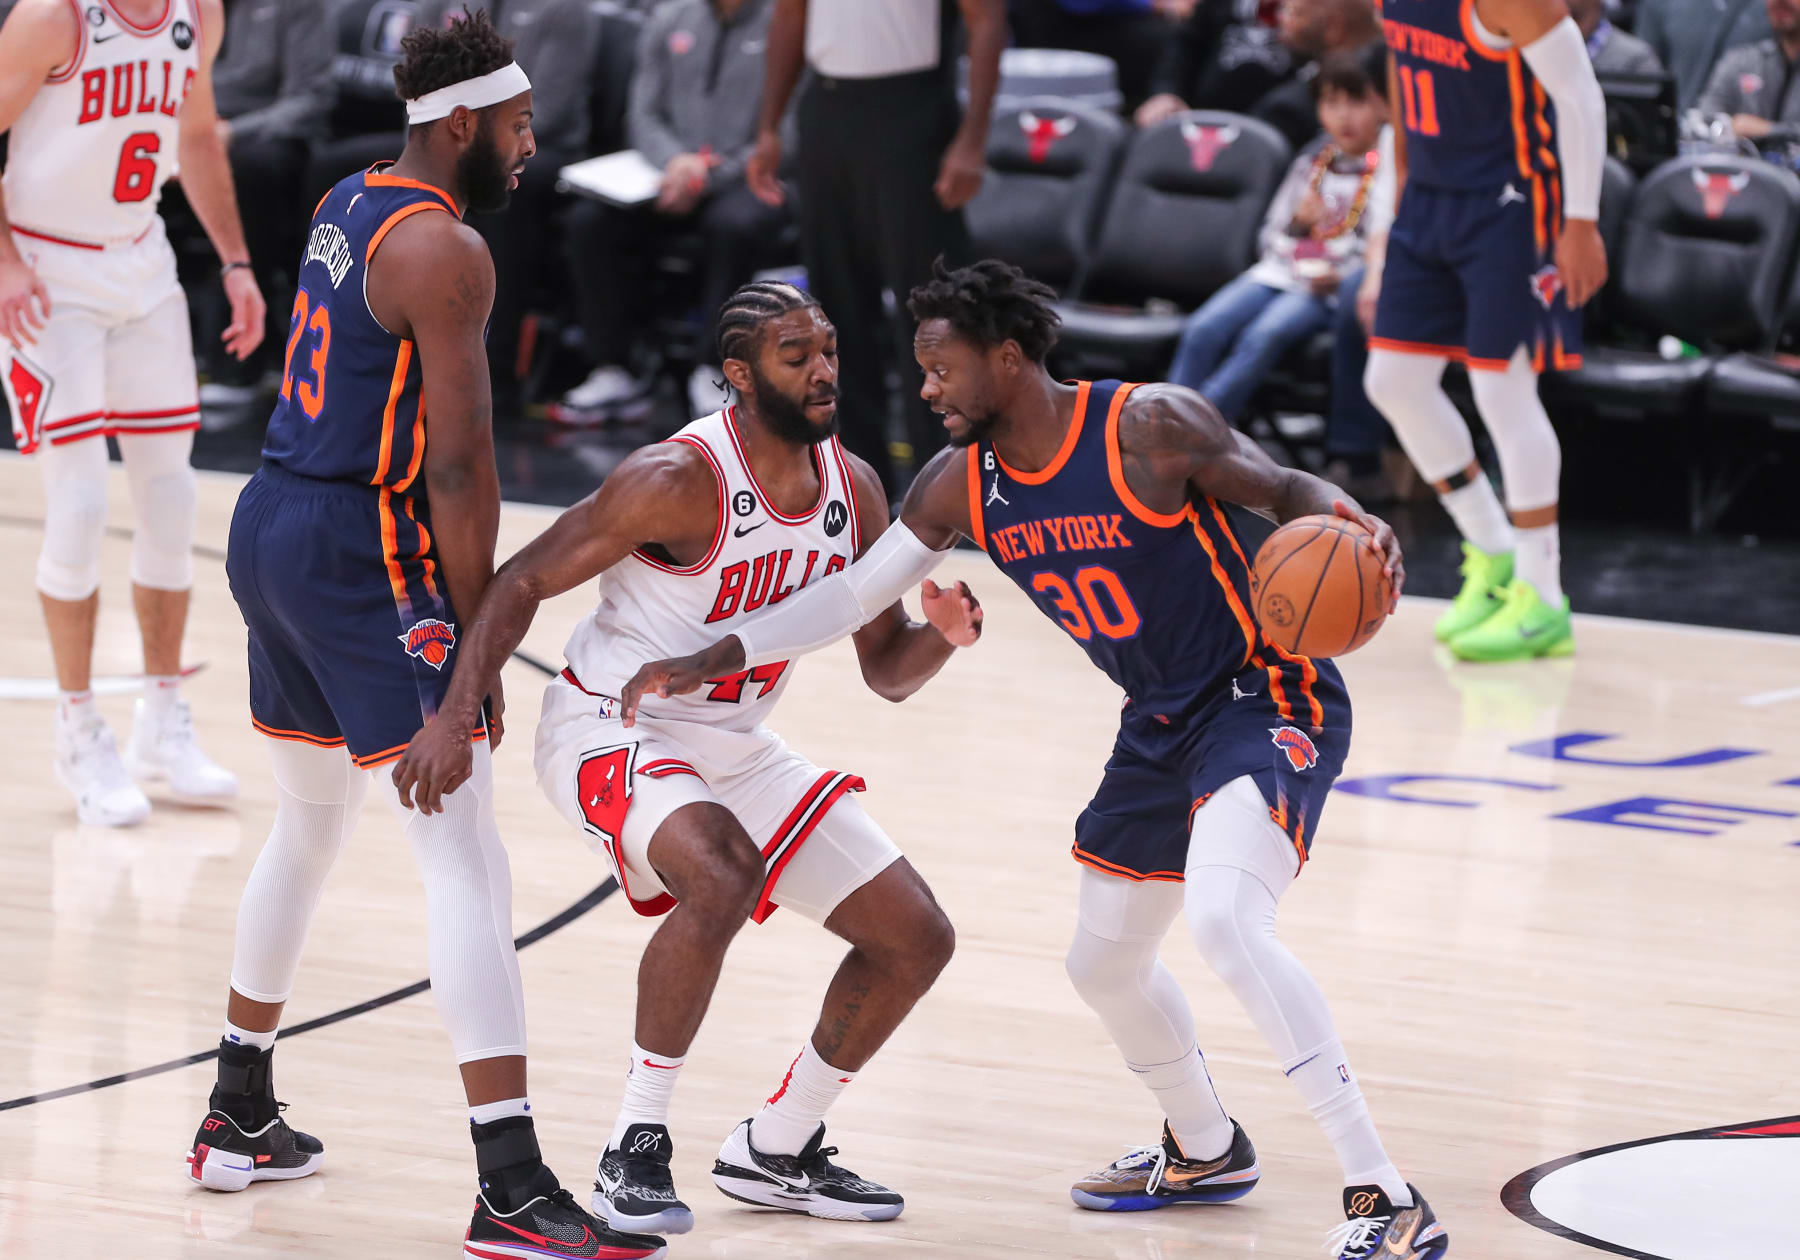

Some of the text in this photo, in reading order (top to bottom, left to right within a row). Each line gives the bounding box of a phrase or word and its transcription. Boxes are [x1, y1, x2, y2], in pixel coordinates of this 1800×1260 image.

[1399, 64, 1440, 136] 11
[113, 132, 160, 204] 6
[304, 223, 354, 290] ROBINSON
[279, 285, 332, 424] 23
[984, 450, 996, 471] 6
[737, 494, 751, 514] 6
[990, 514, 1133, 564] NEW YORK
[1031, 563, 1143, 642] 30
[407, 622, 454, 652] KNICKS
[203, 1117, 227, 1133] GT
